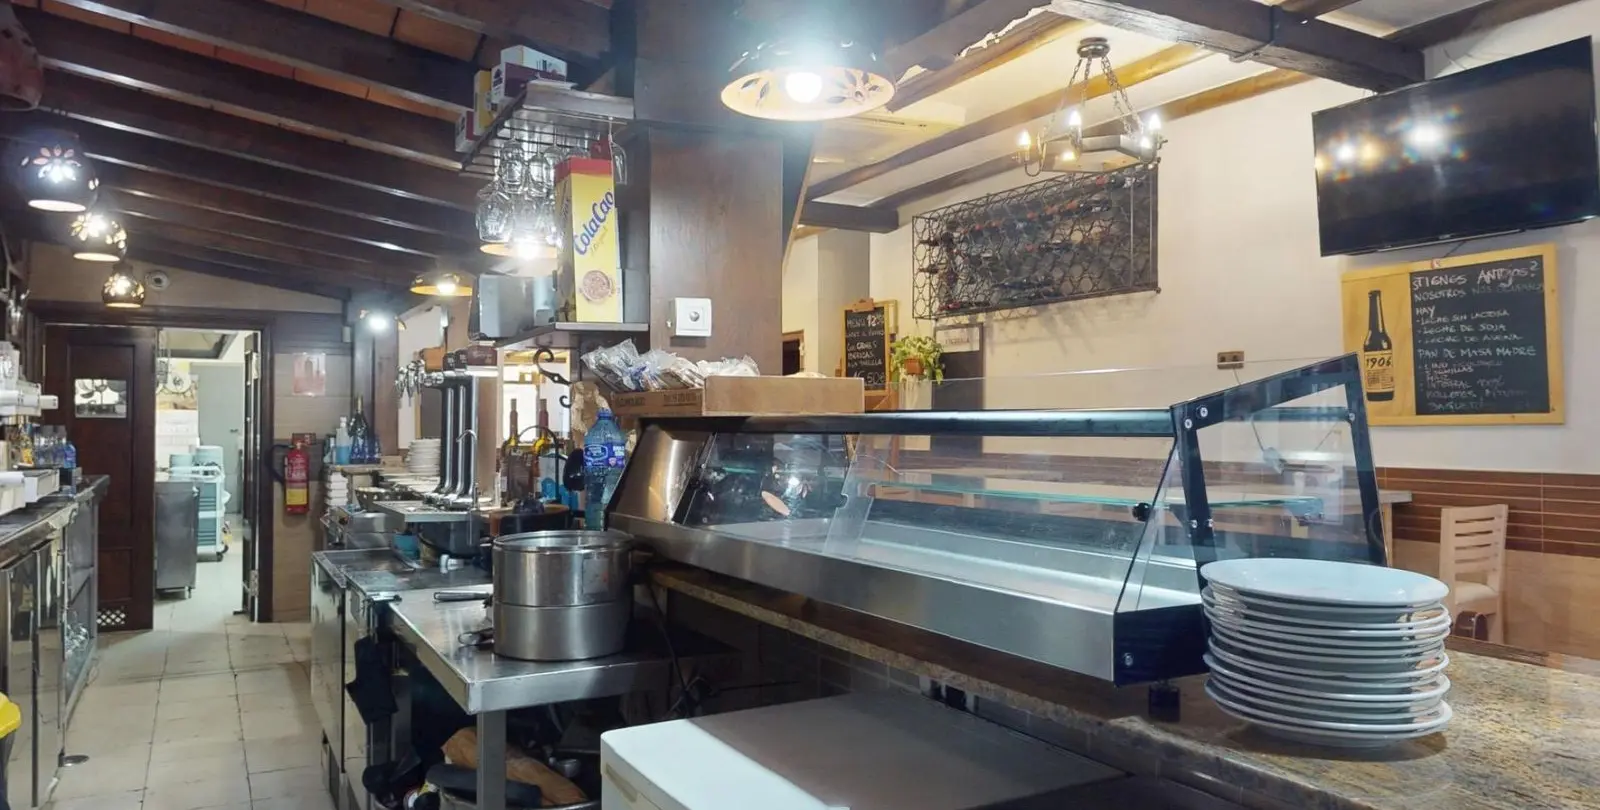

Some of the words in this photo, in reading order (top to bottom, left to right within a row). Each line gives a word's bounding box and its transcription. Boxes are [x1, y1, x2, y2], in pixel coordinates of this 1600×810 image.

[573, 191, 613, 255] ColaCao
[1416, 306, 1435, 318] HAY
[1480, 323, 1506, 332] SOJA
[1460, 347, 1493, 358] MASA
[1496, 346, 1536, 356] MADRE
[1366, 356, 1392, 369] 1906
